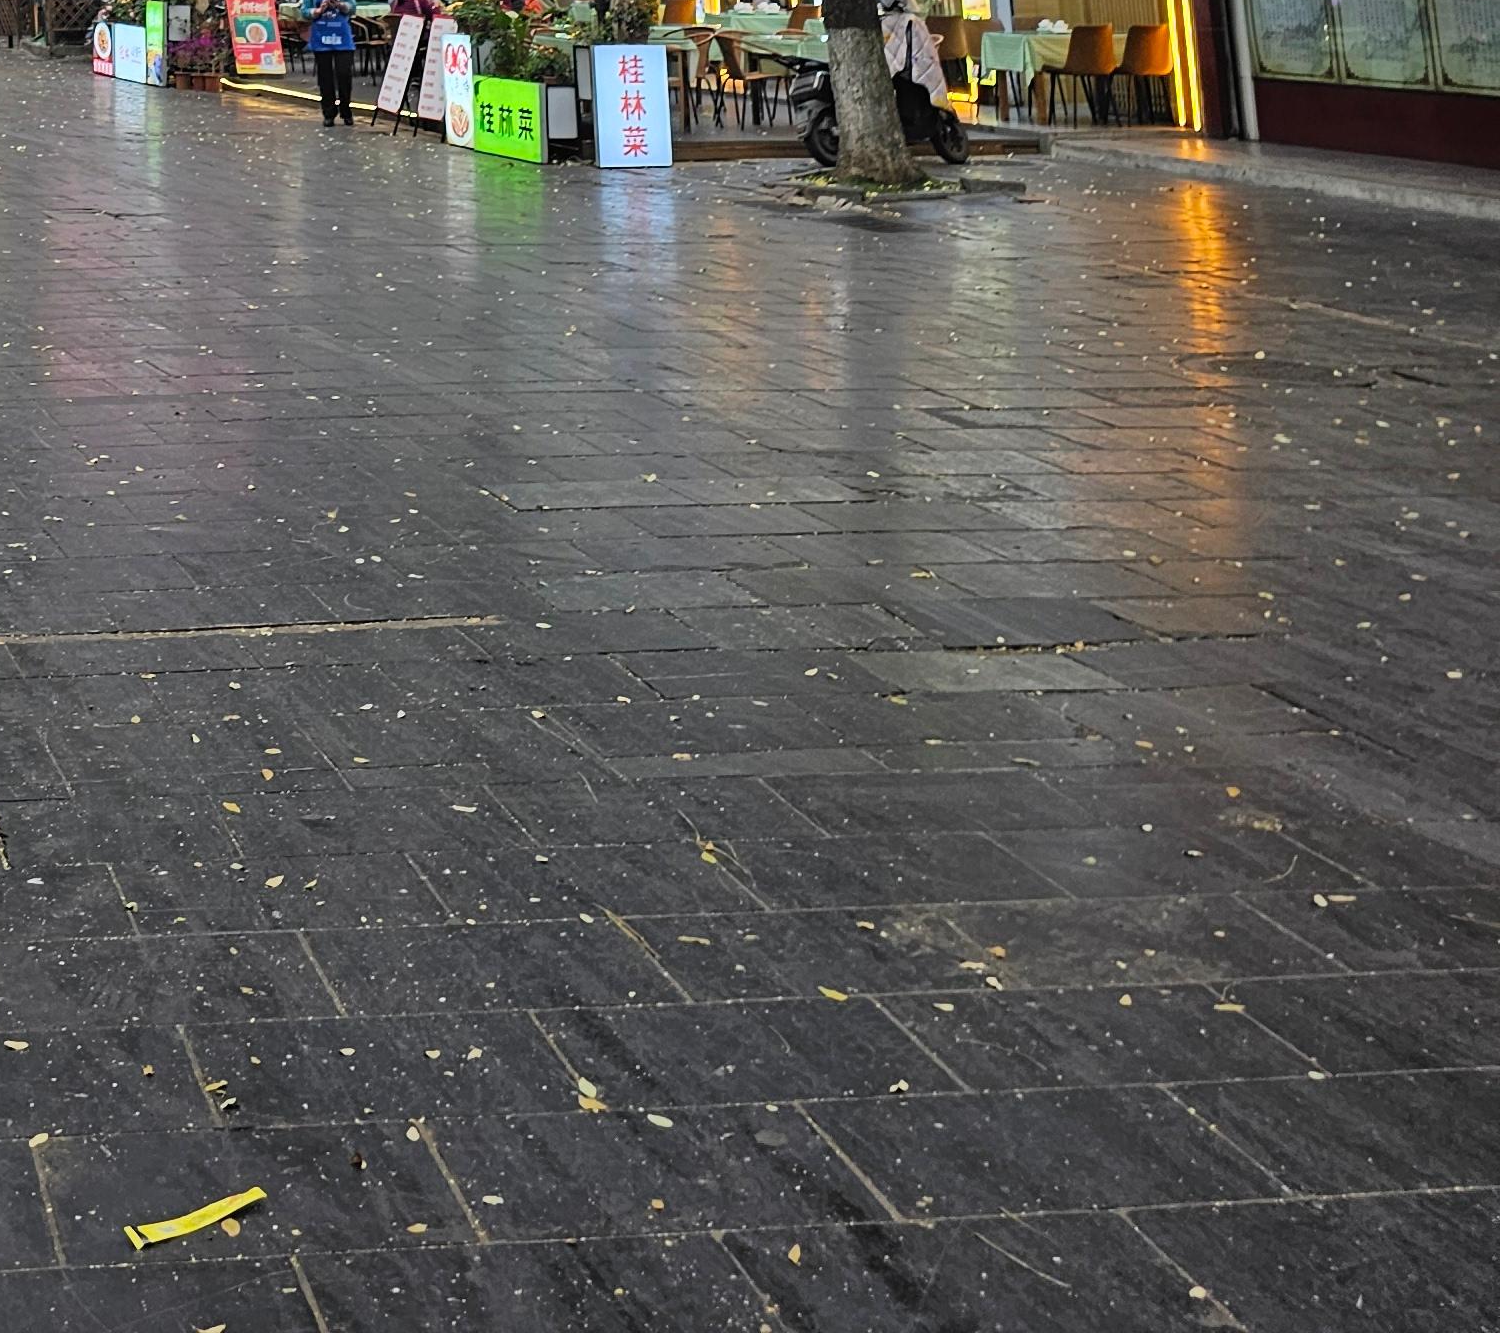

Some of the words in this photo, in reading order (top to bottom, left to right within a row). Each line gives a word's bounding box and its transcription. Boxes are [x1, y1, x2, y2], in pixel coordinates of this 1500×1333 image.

[479, 100, 534, 142] 桂林菜
[617, 54, 649, 158] 桂林菜
